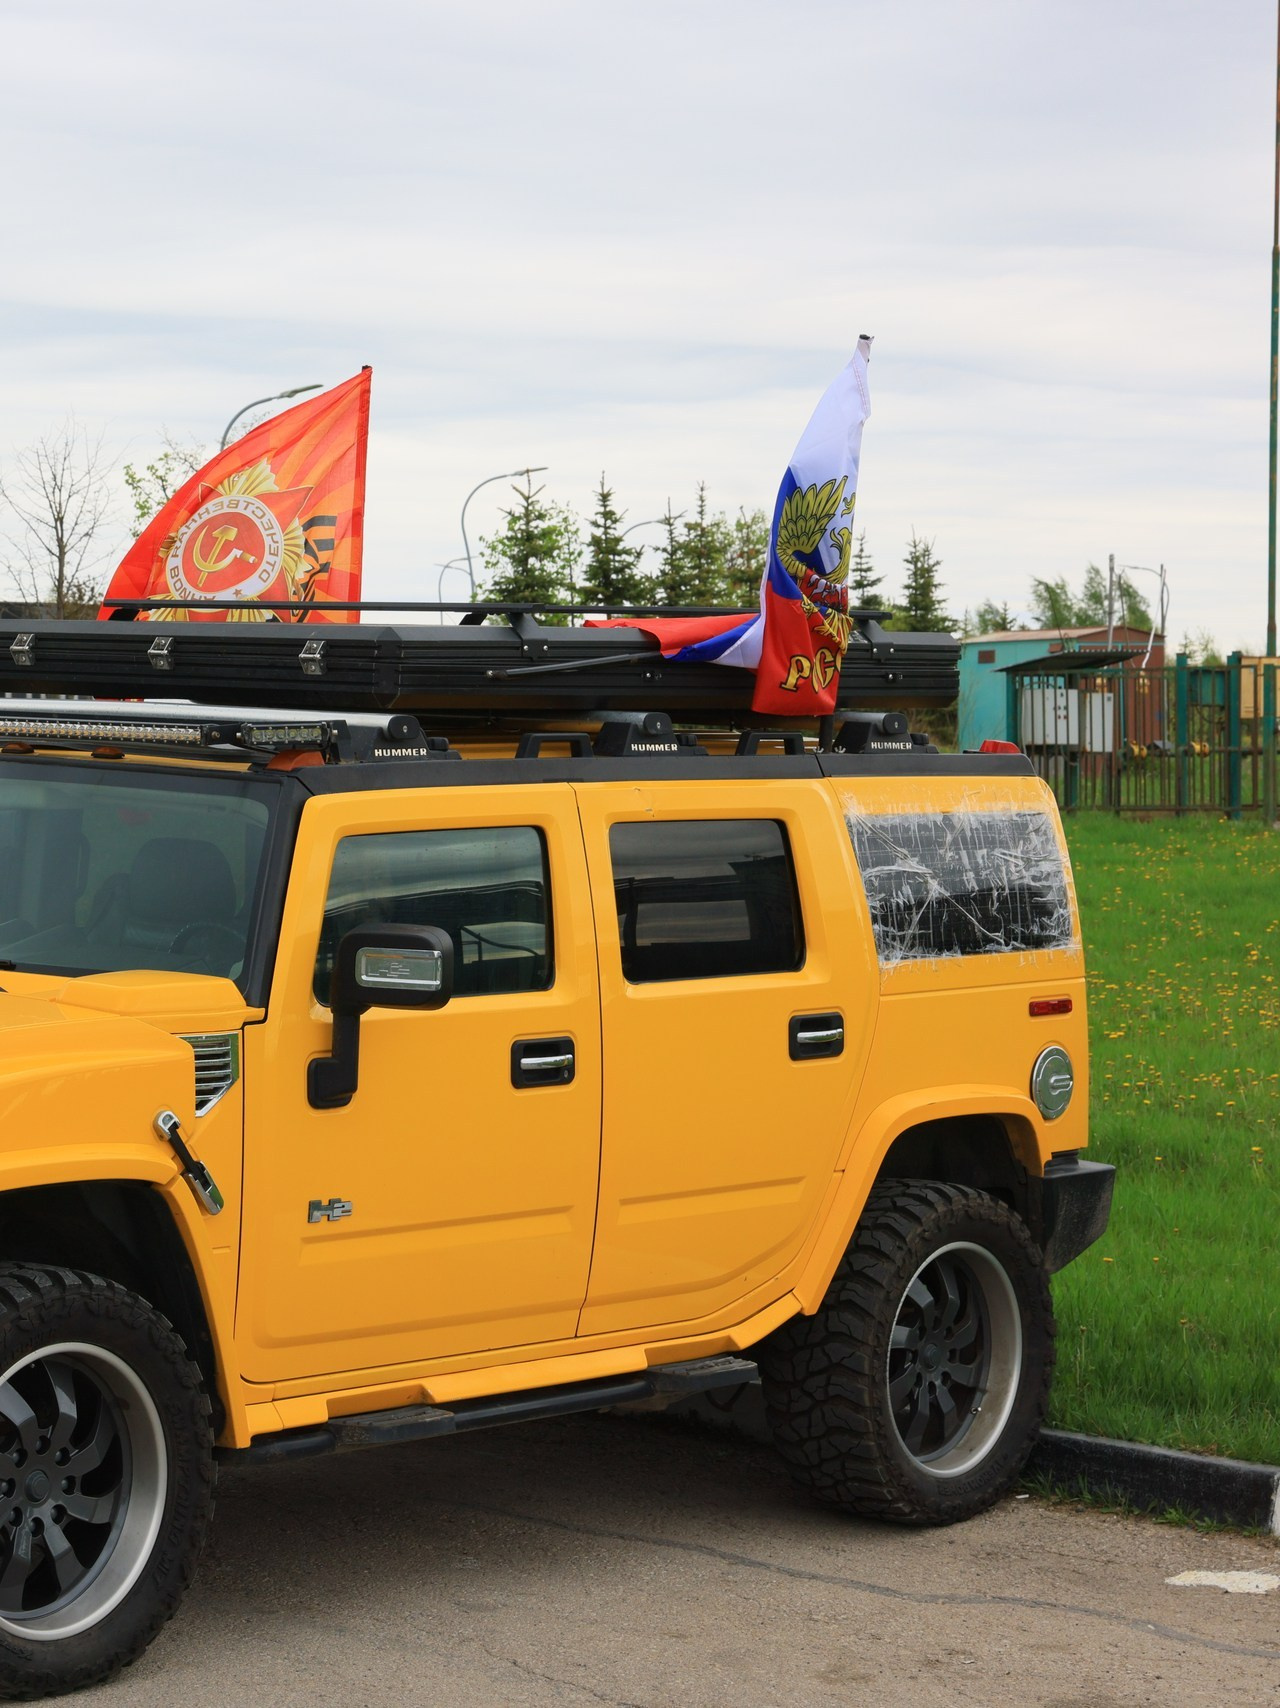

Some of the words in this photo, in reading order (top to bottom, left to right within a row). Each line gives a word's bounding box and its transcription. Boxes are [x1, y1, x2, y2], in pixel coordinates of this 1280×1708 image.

[631, 743, 678, 751] HUMMER
[871, 741, 912, 750] HUMMER
[374, 748, 427, 757] HUMMER
[307, 1198, 352, 1223] H2
